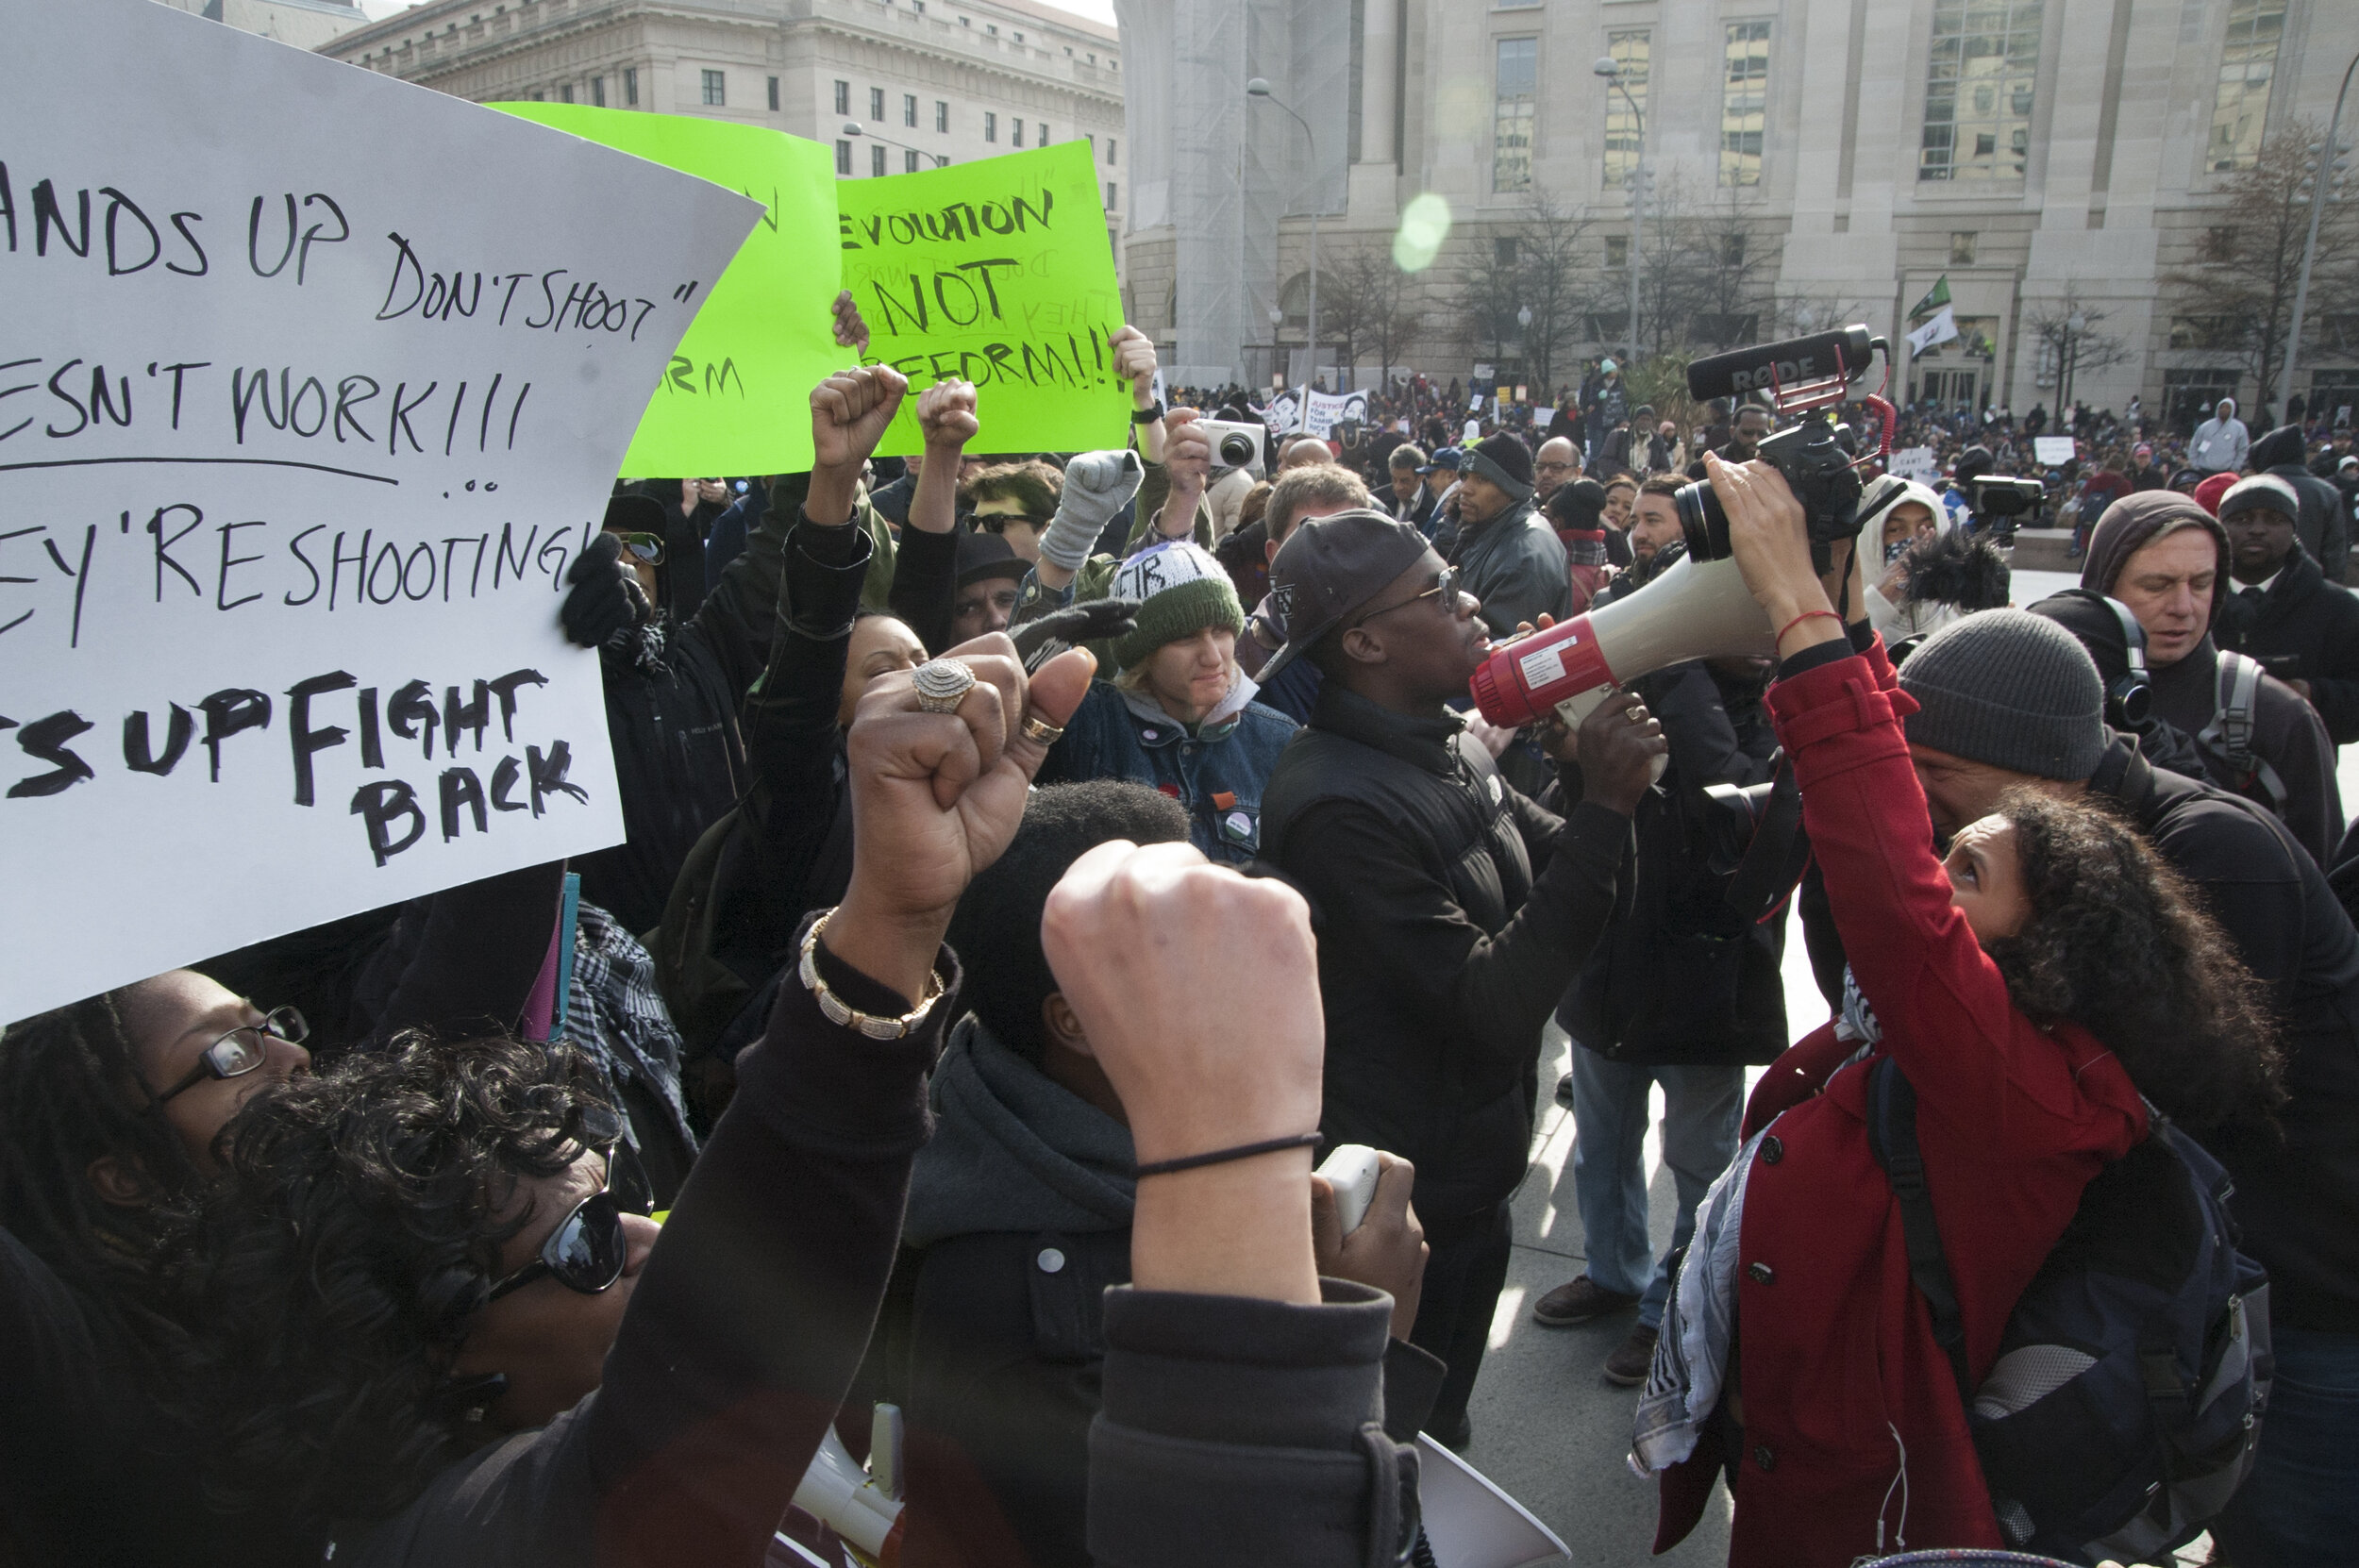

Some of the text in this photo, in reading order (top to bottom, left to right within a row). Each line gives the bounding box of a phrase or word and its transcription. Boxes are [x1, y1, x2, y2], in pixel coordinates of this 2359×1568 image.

[248, 192, 350, 286] UP
[376, 231, 533, 326] DON'T
[872, 258, 1020, 337] NOT
[657, 355, 745, 401] RM
[1311, 400, 1344, 409] JUSTICE
[232, 367, 531, 499] WORK!!!
[123, 688, 272, 783] UP
[283, 668, 549, 808] FIGHT
[350, 740, 589, 868] BACK
